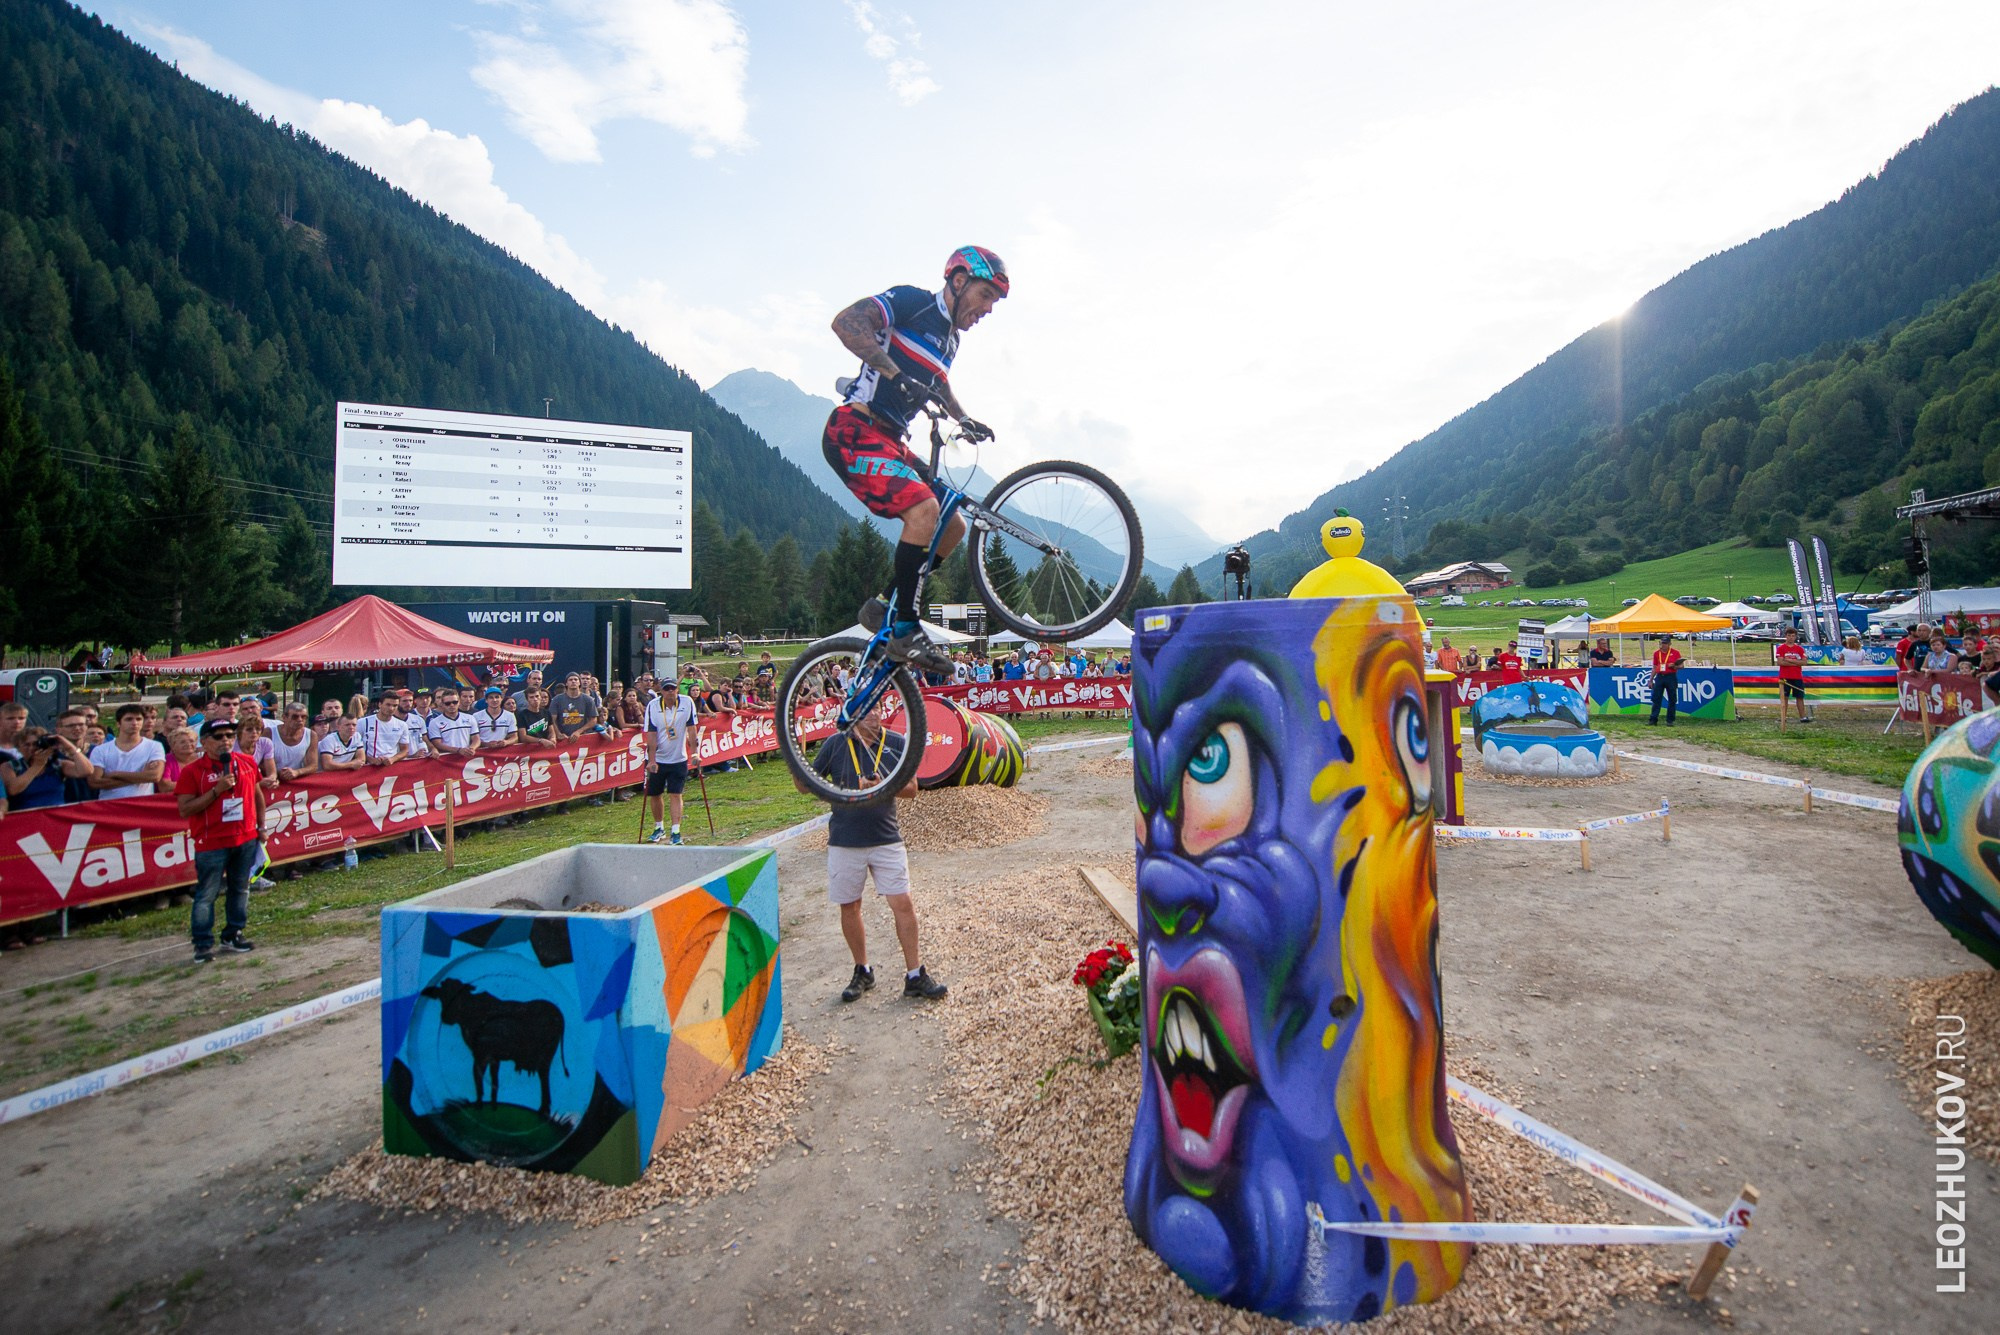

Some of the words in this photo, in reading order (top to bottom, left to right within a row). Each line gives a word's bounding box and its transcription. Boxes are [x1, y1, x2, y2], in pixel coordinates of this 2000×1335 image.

[468, 611, 521, 623] WATCH
[525, 611, 540, 623] IT
[543, 611, 565, 623] ON
[267, 661, 313, 672] 1859
[323, 659, 371, 671] BIRRA
[374, 654, 439, 668] MORETTI
[446, 652, 485, 664] 1859
[967, 687, 1010, 710] Sole
[1012, 686, 1047, 709] Val
[1049, 691, 1064, 705] di
[1063, 682, 1114, 703] Sole
[1612, 676, 1715, 704] TRETINO
[719, 729, 733, 752] di
[731, 715, 774, 748] Sole
[558, 747, 606, 792] Val
[608, 752, 627, 777] di
[352, 776, 429, 832] Val
[462, 756, 551, 804] Sole
[16, 823, 146, 900] Val
[153, 829, 196, 868] di
[265, 790, 342, 836] ole
[1458, 829, 1491, 839] TRENTINO
[1539, 830, 1574, 840] TRENTINO
